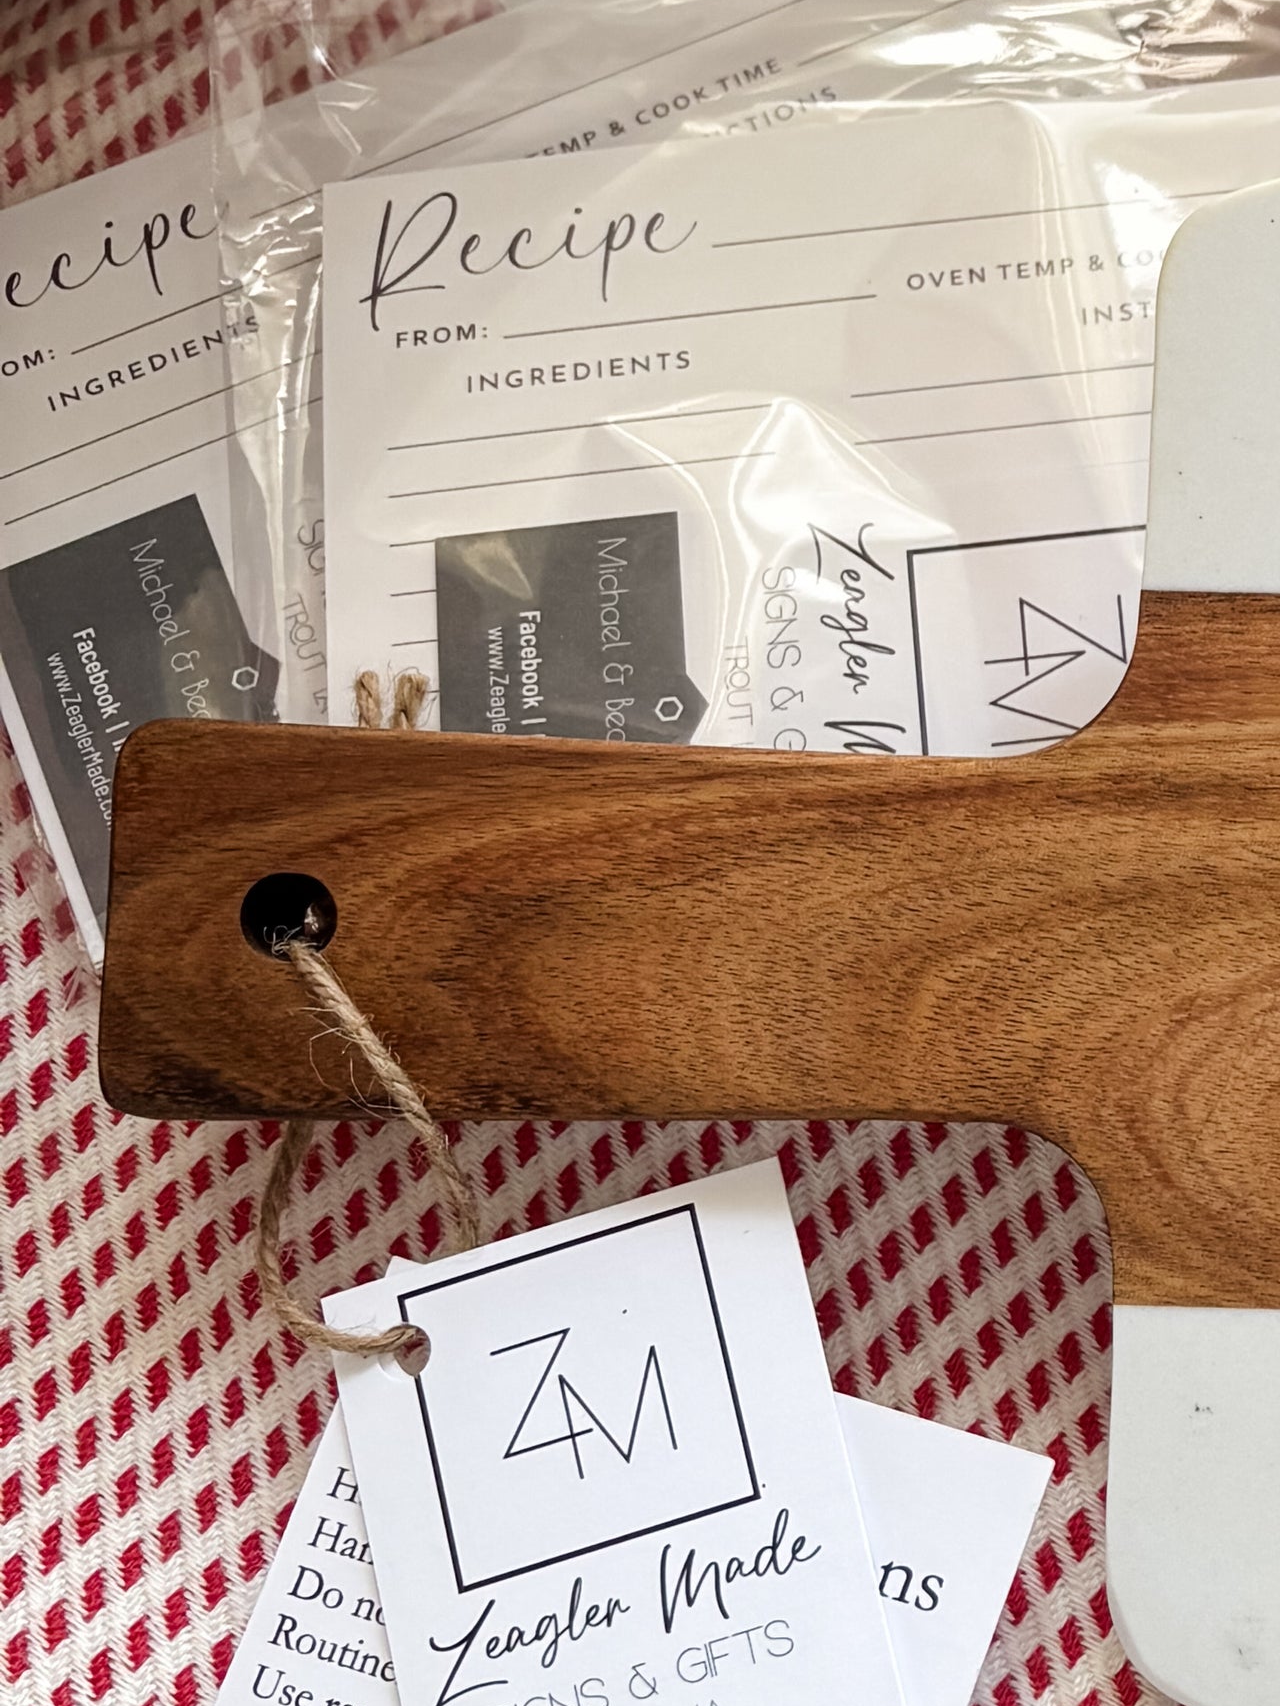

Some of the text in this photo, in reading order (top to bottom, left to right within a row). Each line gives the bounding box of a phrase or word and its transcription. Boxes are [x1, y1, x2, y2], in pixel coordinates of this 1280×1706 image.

[608, 120, 627, 137] &
[635, 86, 706, 126] COOK
[716, 57, 783, 92] TIME
[5, 202, 222, 308] ecipe
[359, 191, 698, 331] Recipe
[906, 266, 986, 291] OVEN
[997, 258, 1074, 281] TEMP
[1088, 254, 1104, 271] &
[396, 323, 488, 349] FROM:
[1081, 301, 1151, 326] INST
[1, 349, 56, 378] OM:
[467, 350, 692, 394] INGREDIENTS
[130, 537, 191, 646] Michael
[171, 650, 200, 674] &
[597, 537, 635, 742] Michael & Bec
[761, 565, 802, 670] SIGNS
[807, 523, 896, 695] Zeagler
[73, 627, 121, 720] Facebook
[486, 626, 511, 735] www.Zeagle
[519, 610, 544, 710] Facebook
[770, 687, 804, 713] &
[287, 1564, 344, 1609] Do
[659, 1508, 822, 1634] Made
[878, 1560, 945, 1612] ns
[267, 1613, 396, 1682] Routine
[628, 1662, 660, 1700] &
[675, 1619, 795, 1684] GIFTS
